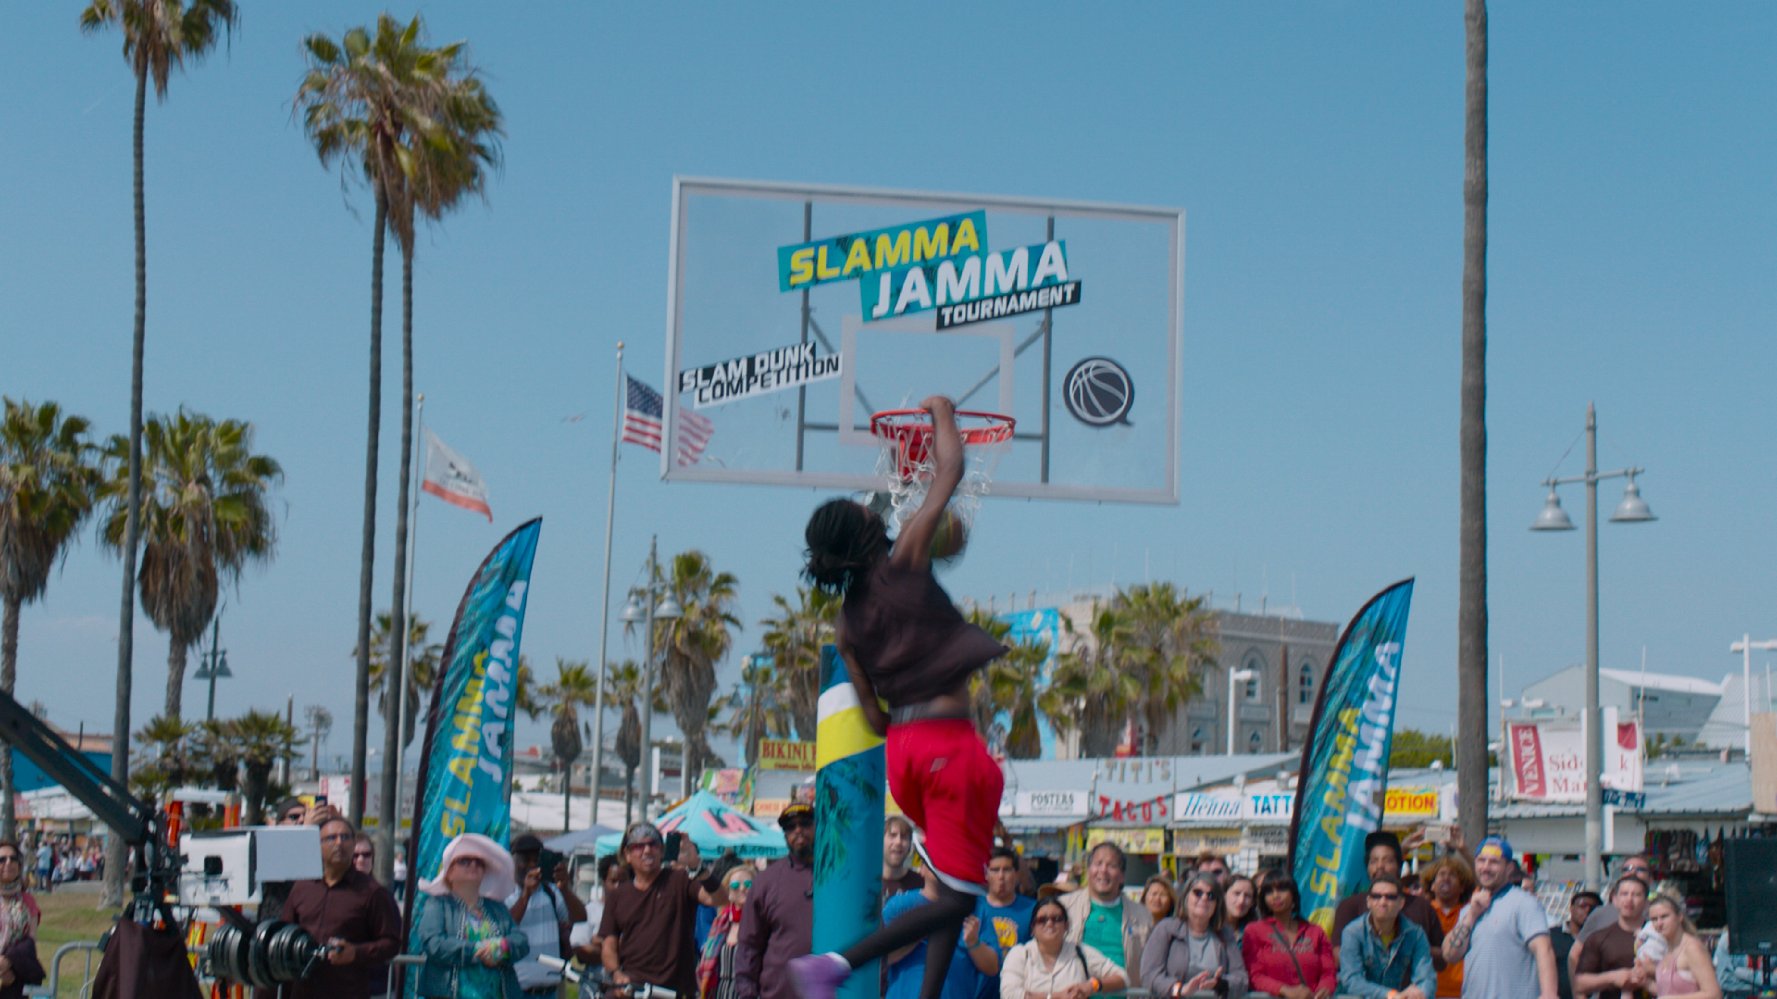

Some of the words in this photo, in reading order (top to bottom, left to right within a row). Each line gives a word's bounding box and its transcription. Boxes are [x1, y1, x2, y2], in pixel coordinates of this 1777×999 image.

[789, 218, 980, 286] SLAMMA
[871, 240, 1068, 319] JAMMA
[940, 282, 1077, 327] TOURNAMENT
[682, 356, 748, 393] SLAM
[754, 342, 814, 374] DUNK
[698, 355, 839, 404] COMPETITION
[762, 741, 807, 762] BIKINI
[1518, 727, 1540, 796] VENICE
[1031, 792, 1074, 806] POSTERS
[1098, 795, 1168, 823] TACOS
[1184, 792, 1240, 817] Henna
[1251, 795, 1292, 815] TATT
[1309, 706, 1361, 899] SLAMMA
[1387, 795, 1434, 810] OTION
